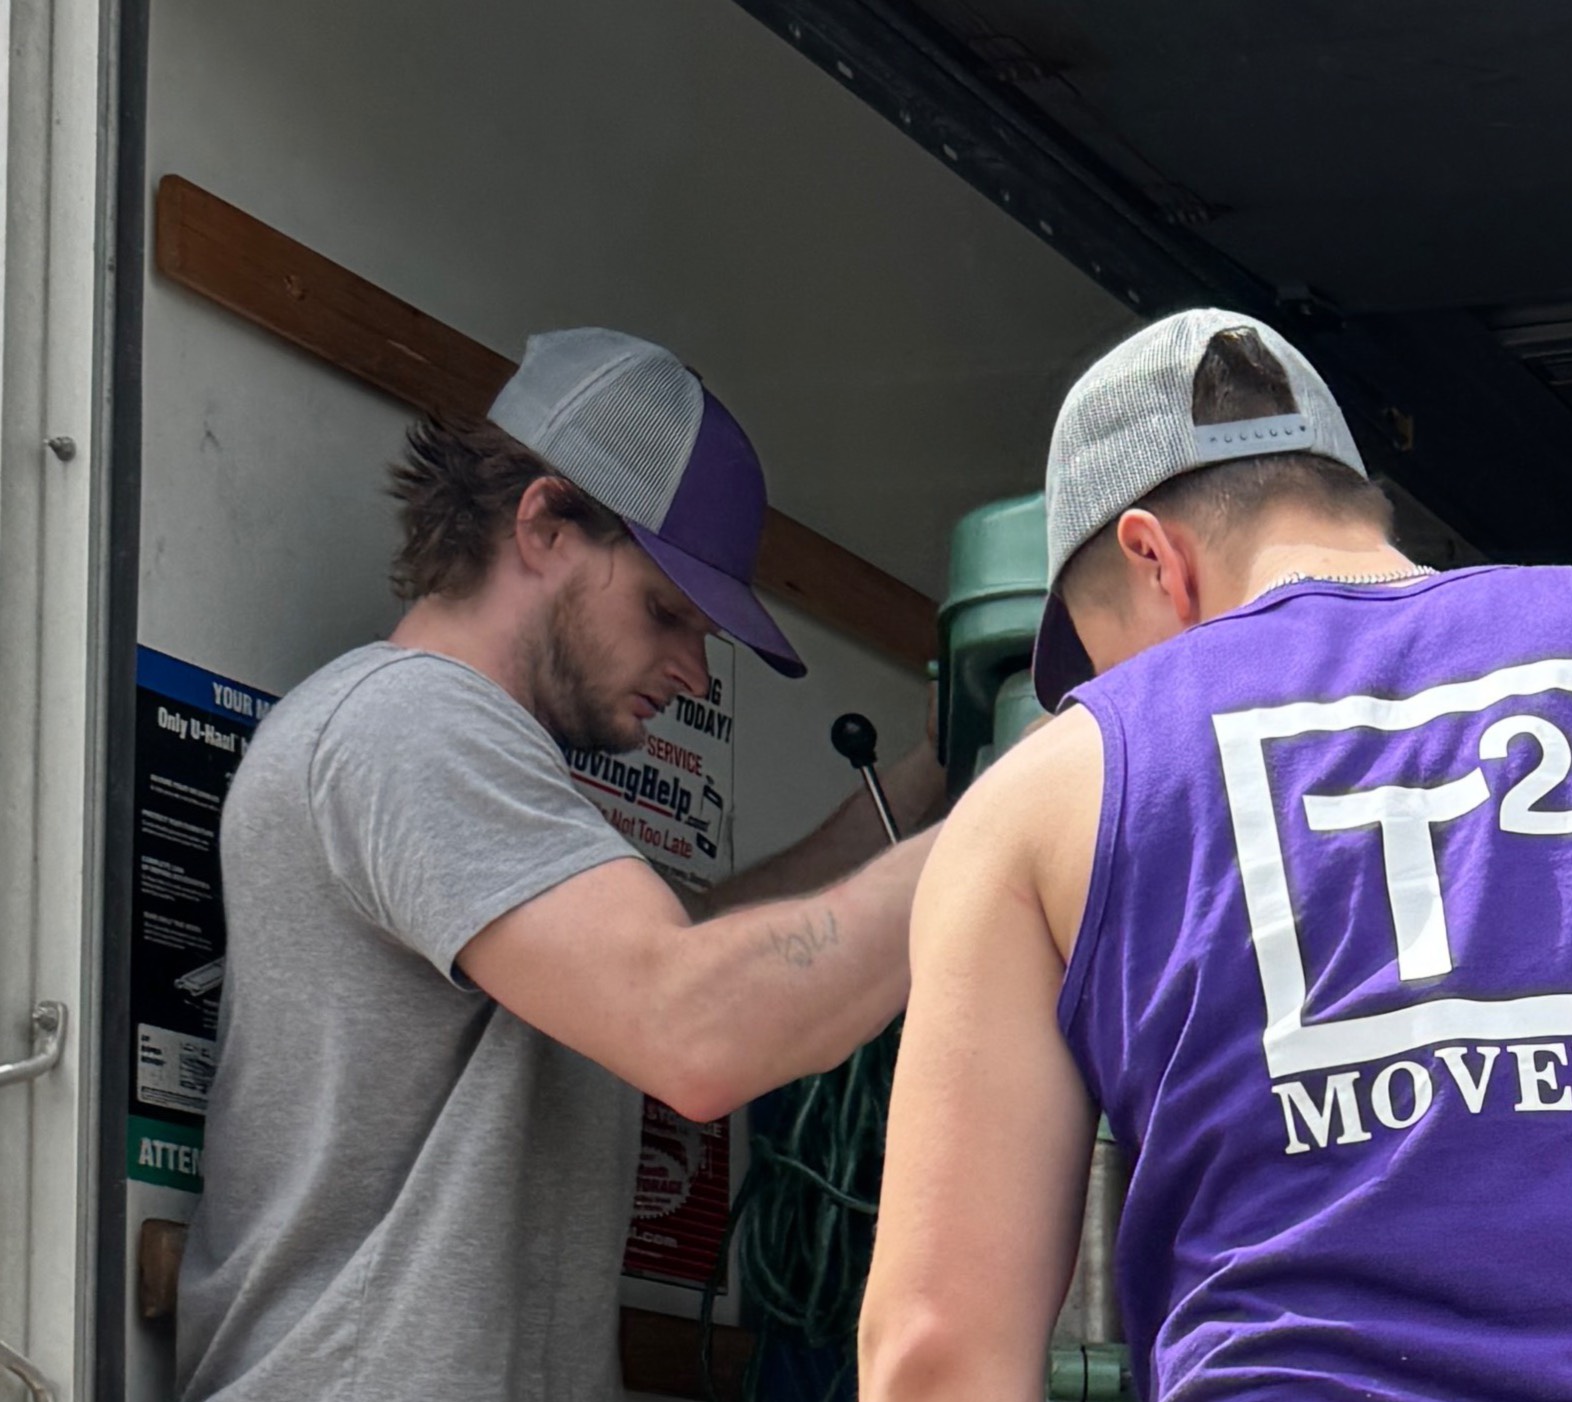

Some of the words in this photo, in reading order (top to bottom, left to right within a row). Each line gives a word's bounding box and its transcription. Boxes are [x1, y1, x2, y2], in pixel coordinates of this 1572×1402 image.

[213, 682, 253, 717] YOUR
[676, 694, 733, 744] TODAY!
[157, 707, 188, 739] Only
[190, 718, 235, 752] U-Haul
[647, 735, 703, 776] SERVICE
[611, 808, 636, 838] Not
[639, 818, 662, 846] Too
[663, 829, 693, 859] Late
